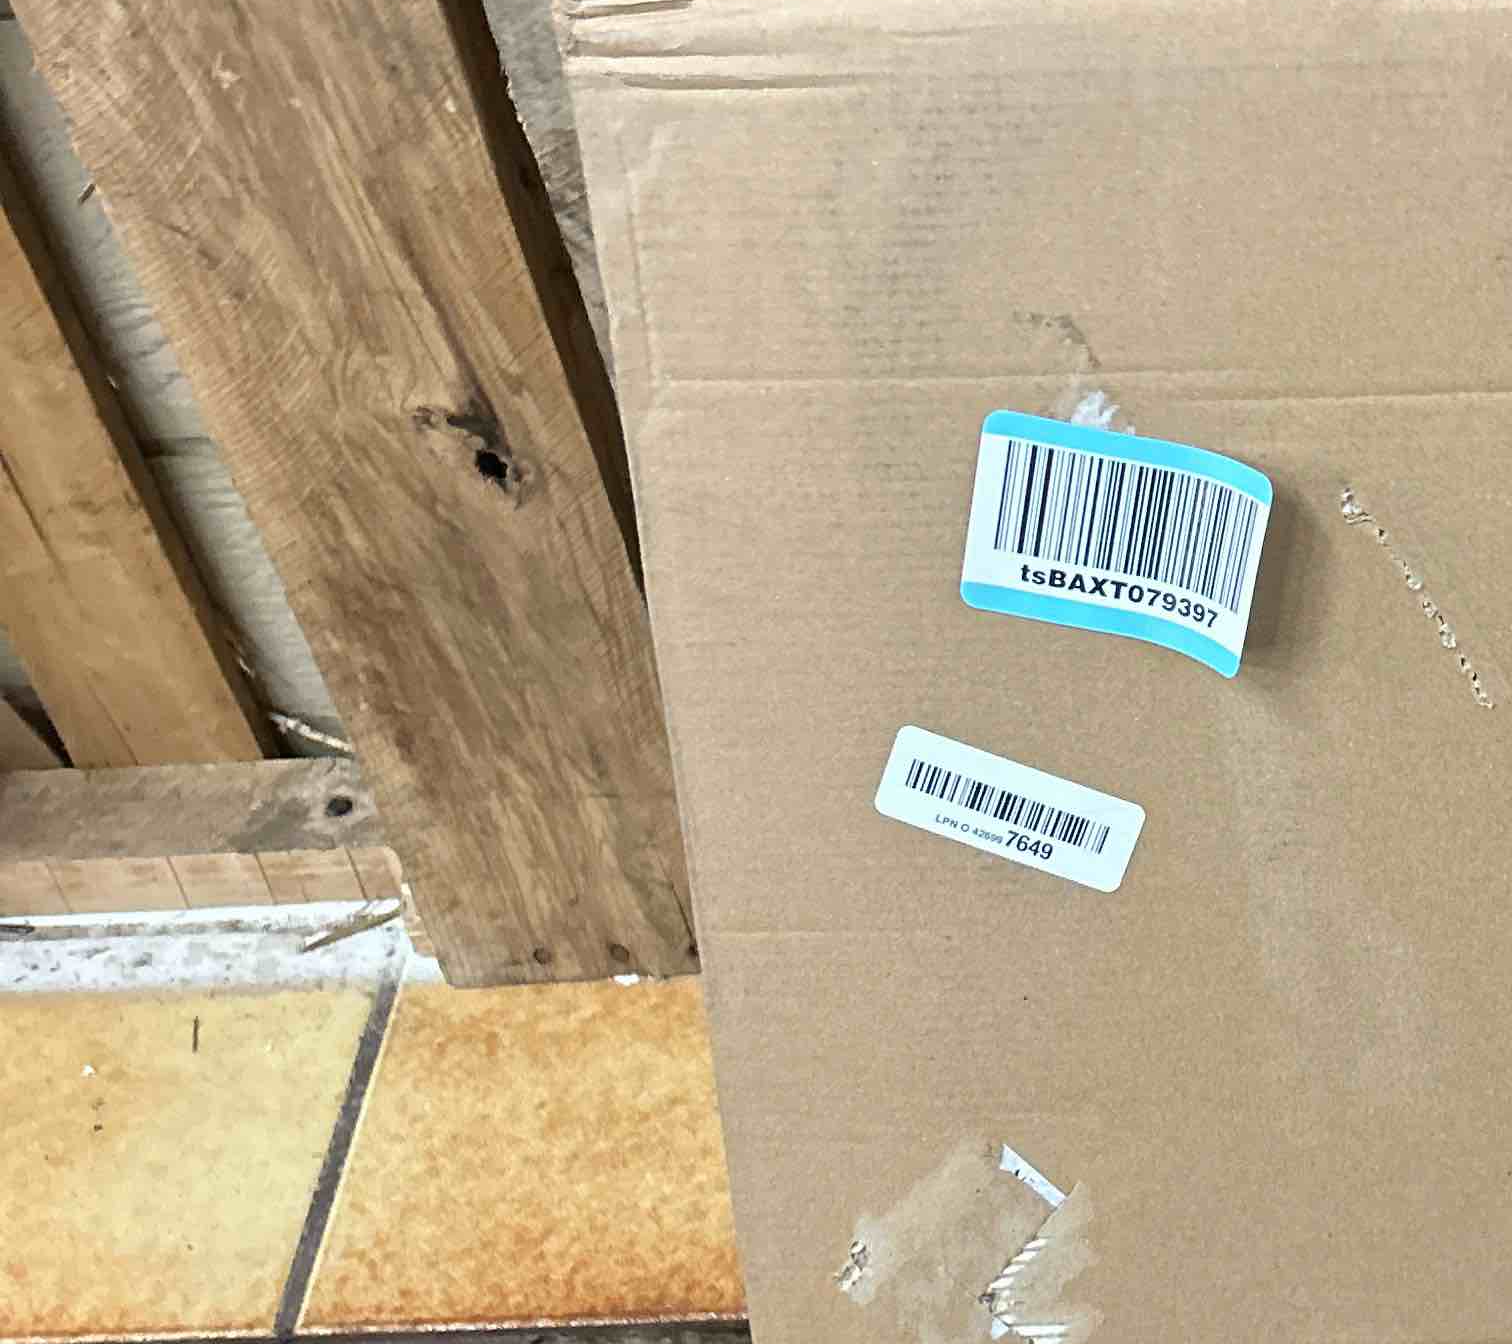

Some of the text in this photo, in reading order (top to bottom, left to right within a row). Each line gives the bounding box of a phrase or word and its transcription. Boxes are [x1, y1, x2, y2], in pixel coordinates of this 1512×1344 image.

[1020, 564, 1219, 629] tsBAXT079397
[935, 814, 958, 828] LPN
[1005, 829, 1054, 860] 7649
